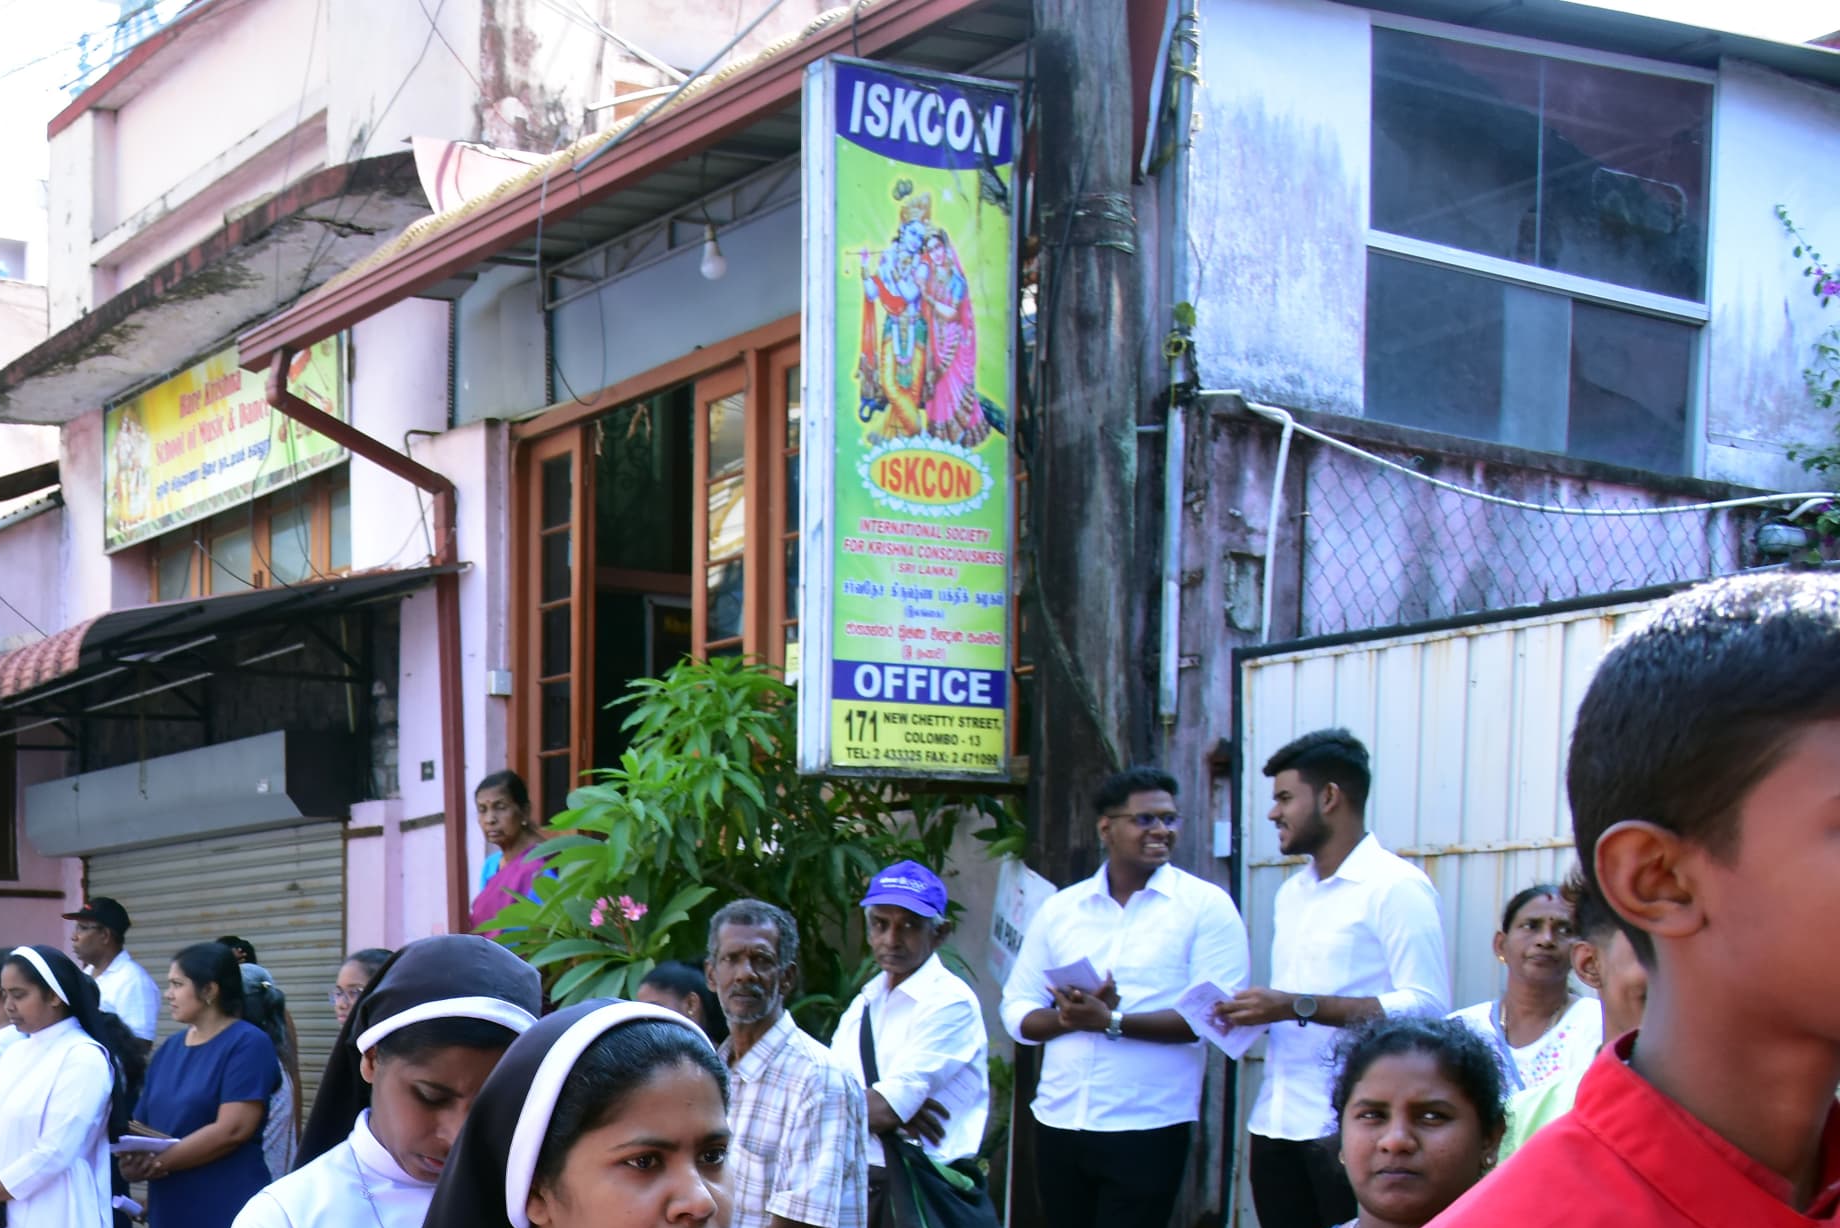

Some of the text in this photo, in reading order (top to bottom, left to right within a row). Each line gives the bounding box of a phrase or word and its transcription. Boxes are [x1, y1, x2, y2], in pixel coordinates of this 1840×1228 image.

[849, 80, 1005, 156] ISKCON
[879, 456, 972, 499] ISKCON
[861, 519, 990, 543] INTERNATIONAL SOCIETY
[844, 538, 1005, 565] FOR KRISHNA CONSCIOUSNESS
[853, 664, 992, 704] OFFICE
[845, 709, 1002, 743] 171 NEW CHETTY STREET,
[904, 731, 959, 746] COLOMBO
[969, 734, 981, 747] 13
[846, 747, 871, 760] TEL:
[873, 748, 880, 760] 2
[925, 750, 951, 764] FAX:
[952, 751, 959, 764] 2
